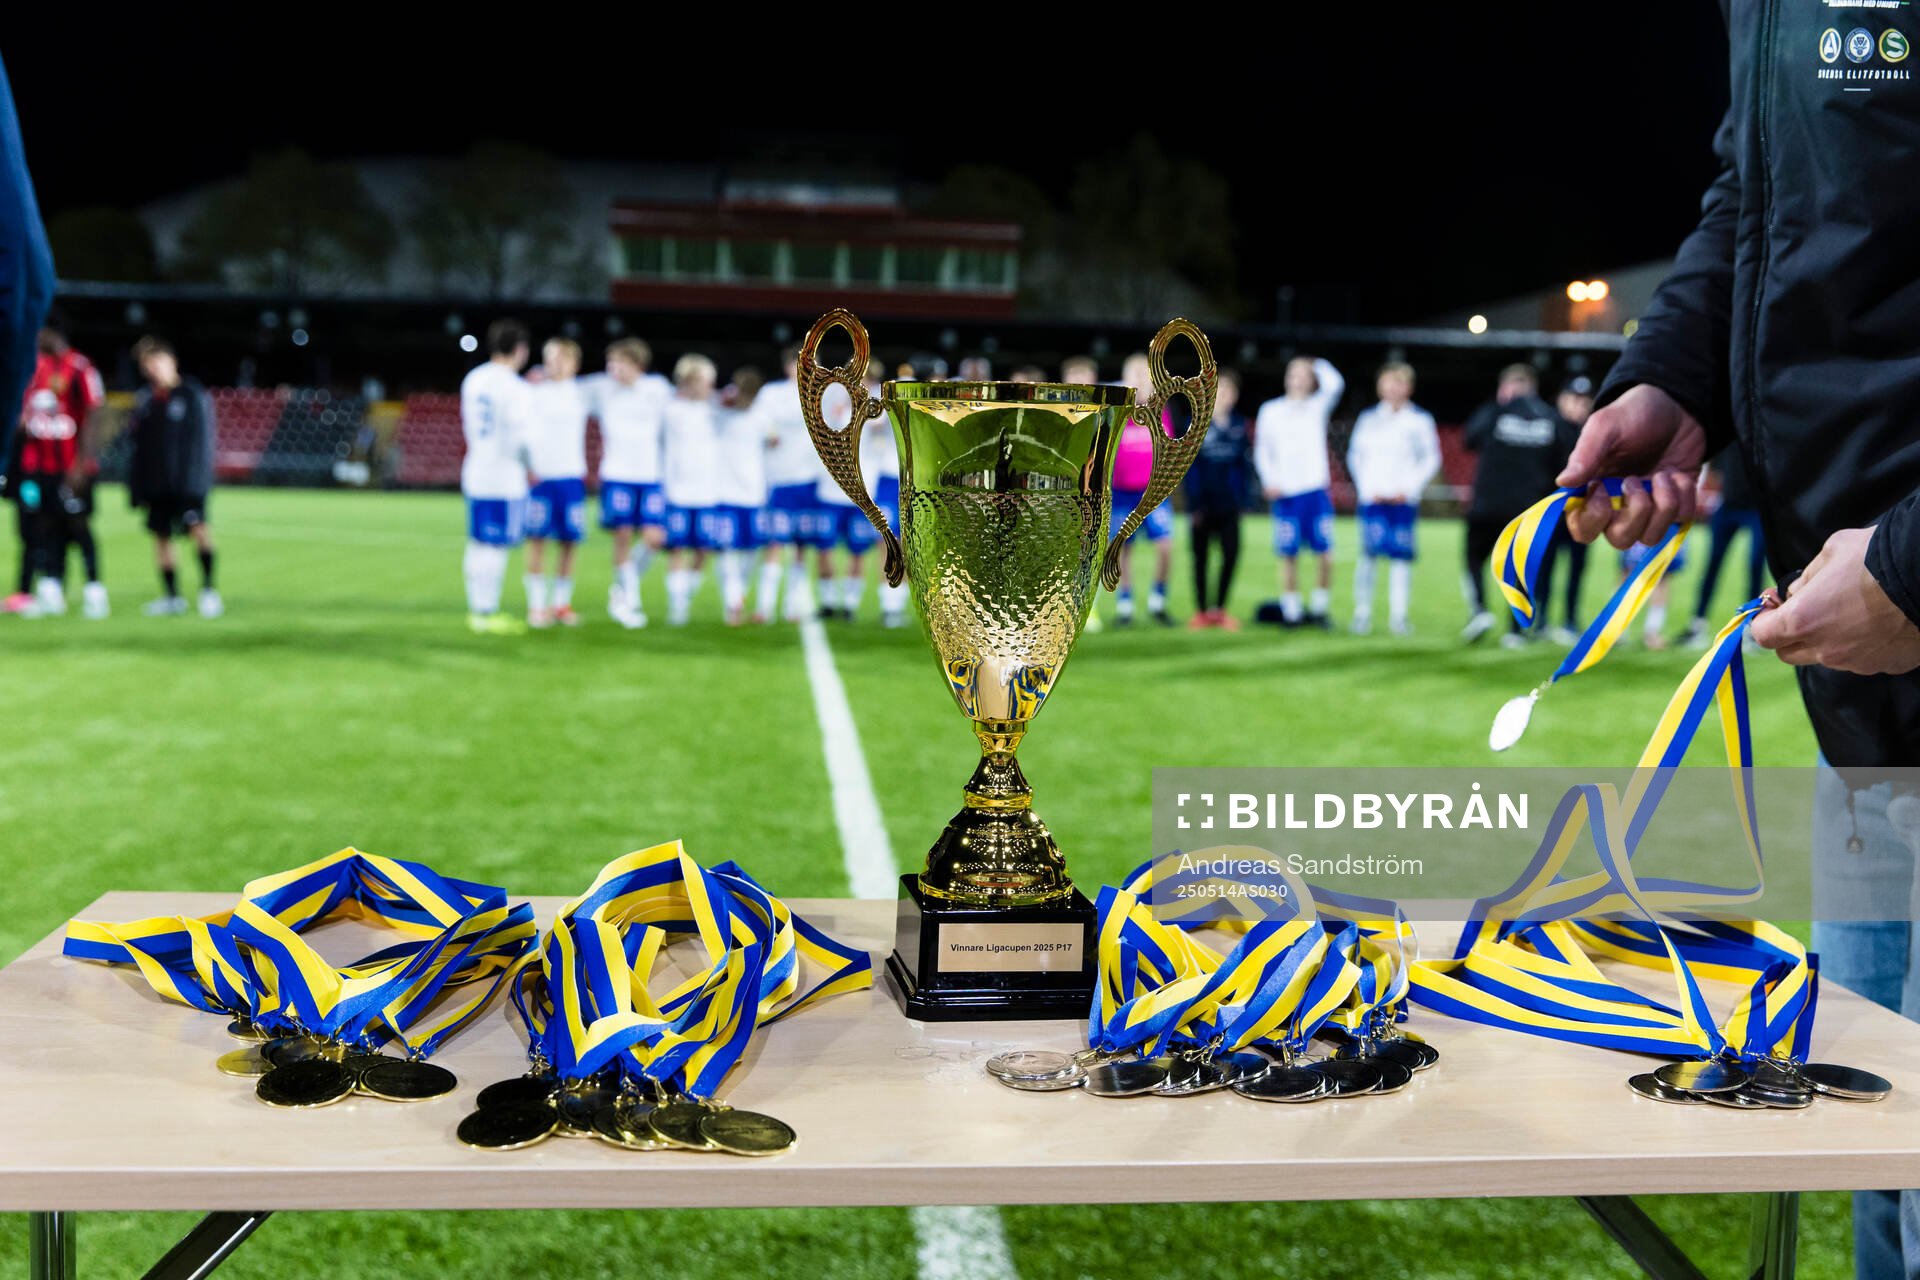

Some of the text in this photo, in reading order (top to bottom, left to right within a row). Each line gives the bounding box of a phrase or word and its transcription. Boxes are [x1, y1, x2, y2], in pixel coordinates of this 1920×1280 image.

[1846, 69, 1910, 80] ELITFOTBOLL
[950, 943, 1073, 953] Vinnare Ligacupen 2025 P17
